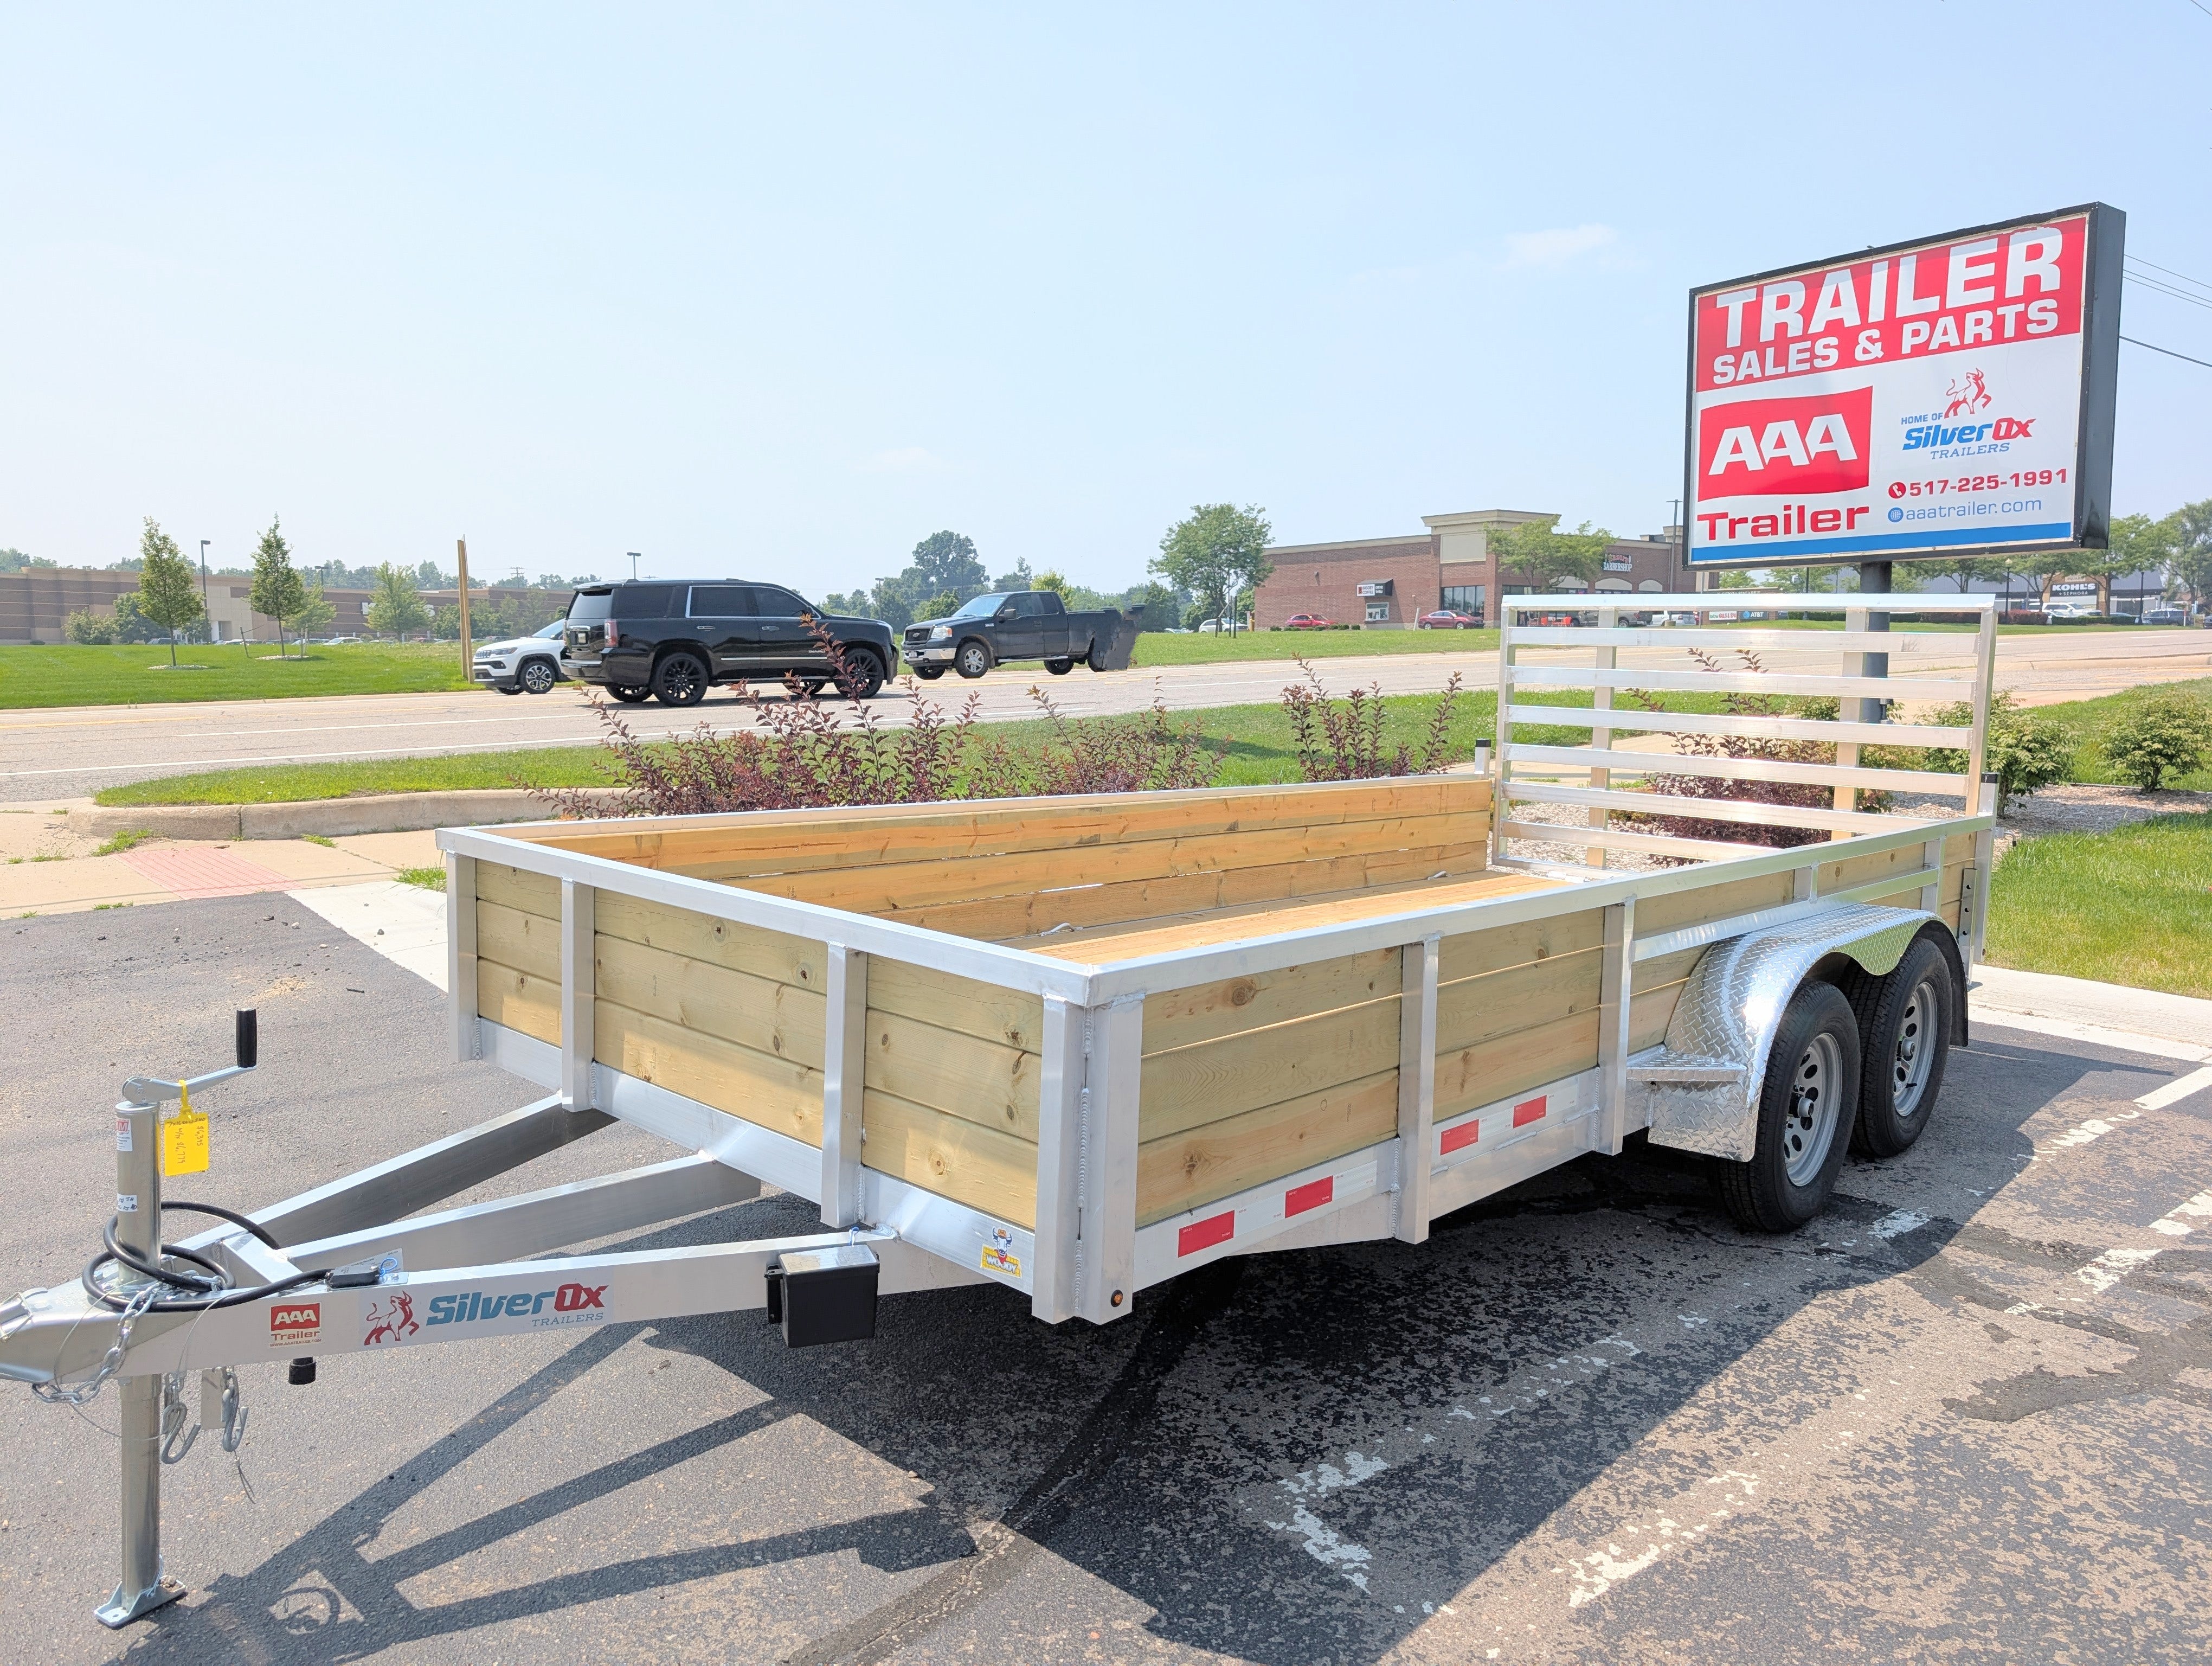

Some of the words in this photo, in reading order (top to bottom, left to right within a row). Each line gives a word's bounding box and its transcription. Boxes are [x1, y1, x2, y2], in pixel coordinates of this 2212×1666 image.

[1716, 227, 2062, 348] TRAILER
[1713, 337, 1838, 384] SALES
[1855, 329, 1884, 361] &
[1901, 299, 2058, 355] PARTS
[1901, 414, 1928, 425] HOME
[1931, 412, 1943, 421] OF
[1708, 413, 1858, 475] AAA
[1930, 443, 2010, 459] TRAILERS
[1909, 469, 2067, 496] 517-225-1991
[1906, 499, 2042, 520] aaatrailer.com
[1697, 504, 1869, 541] Trailer
[1603, 562, 1632, 572] BARBERSHOP
[986, 1253, 1018, 1274] WOODY
[274, 1310, 317, 1325] AAA
[531, 1312, 603, 1327] TRAILERS
[271, 1331, 320, 1341] Trailer
